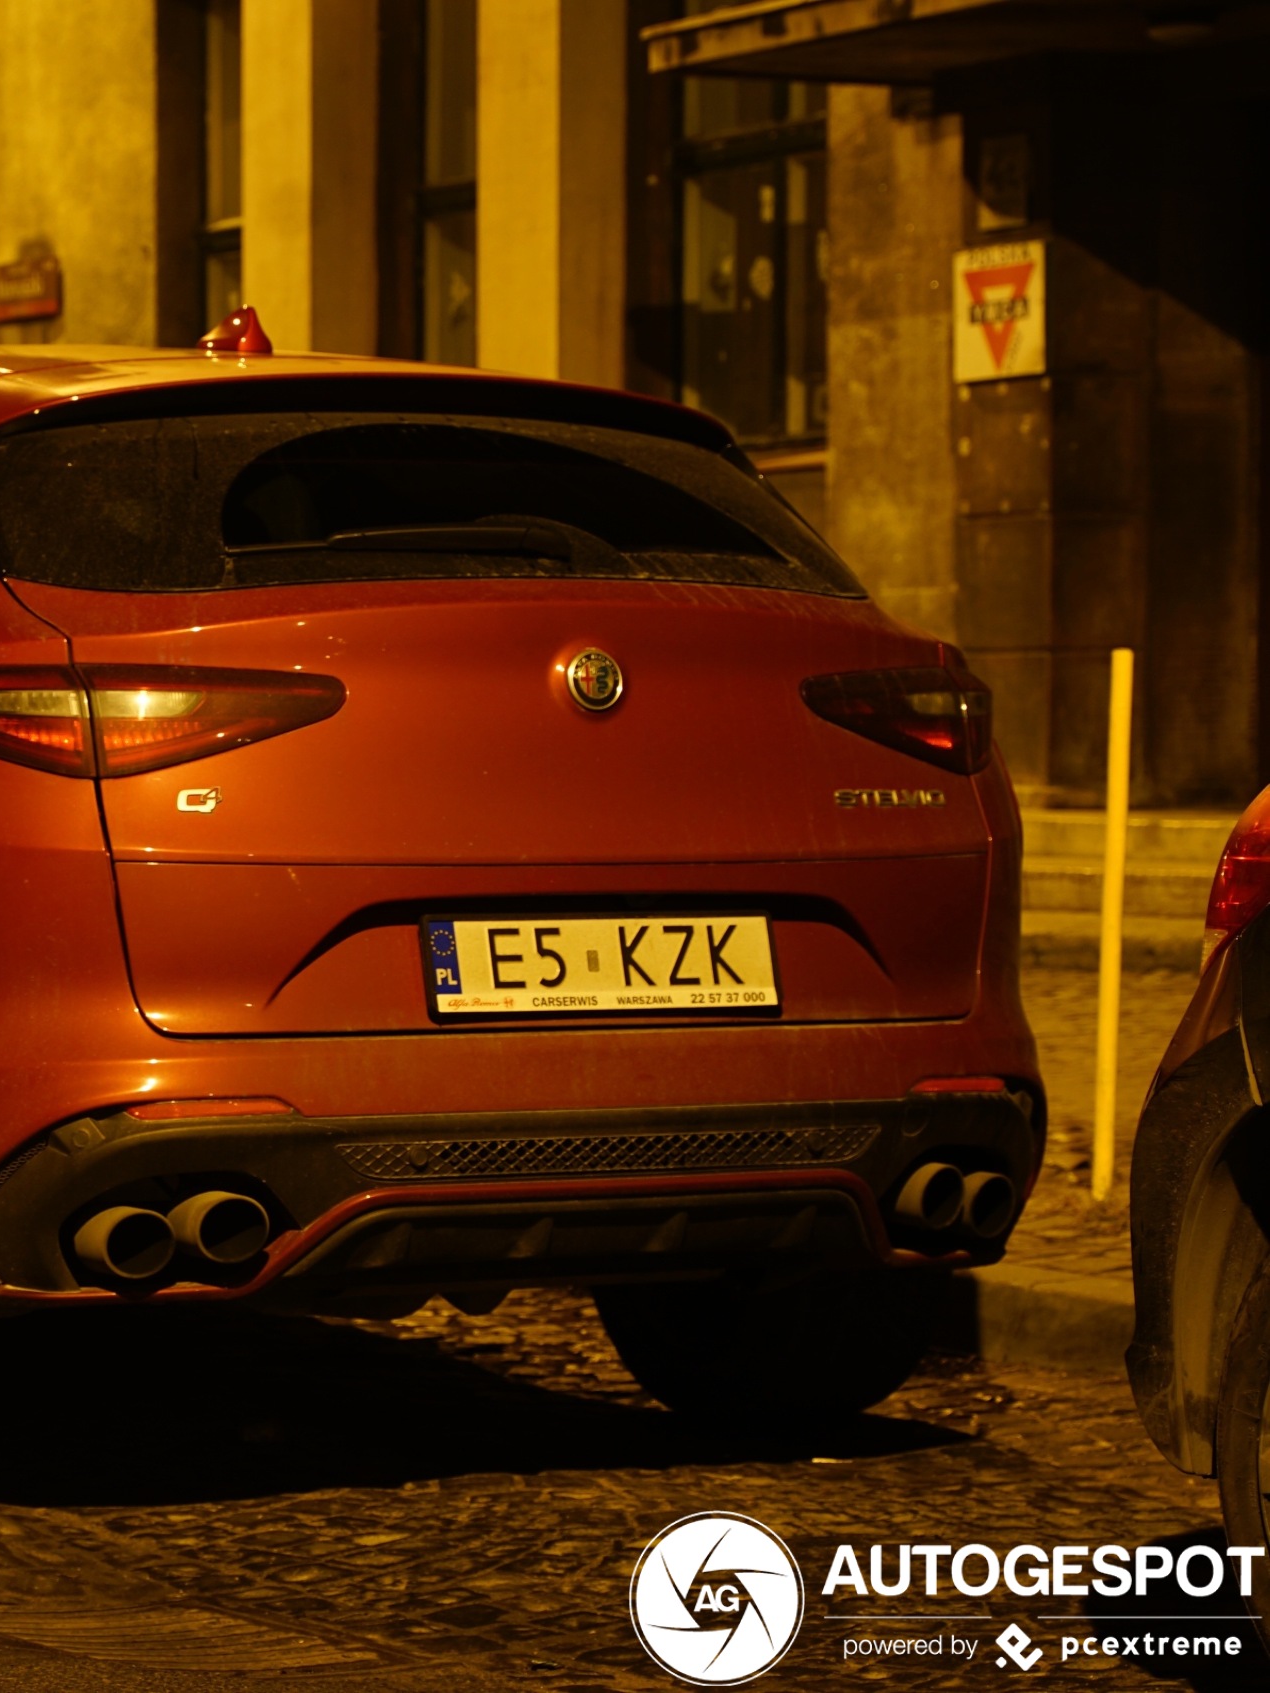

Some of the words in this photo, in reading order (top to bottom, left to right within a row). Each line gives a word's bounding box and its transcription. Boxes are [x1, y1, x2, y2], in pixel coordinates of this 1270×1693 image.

[833, 789, 946, 808] STELVIO
[487, 928, 566, 988] E5
[618, 924, 744, 987] KZK
[435, 968, 458, 986] PL
[532, 996, 598, 1008] CARSERWIS
[616, 995, 674, 1006] WARSZAWA
[690, 993, 706, 1004] 22
[709, 993, 723, 1004] 57
[725, 992, 741, 1003] 37
[743, 991, 767, 1002] 000
